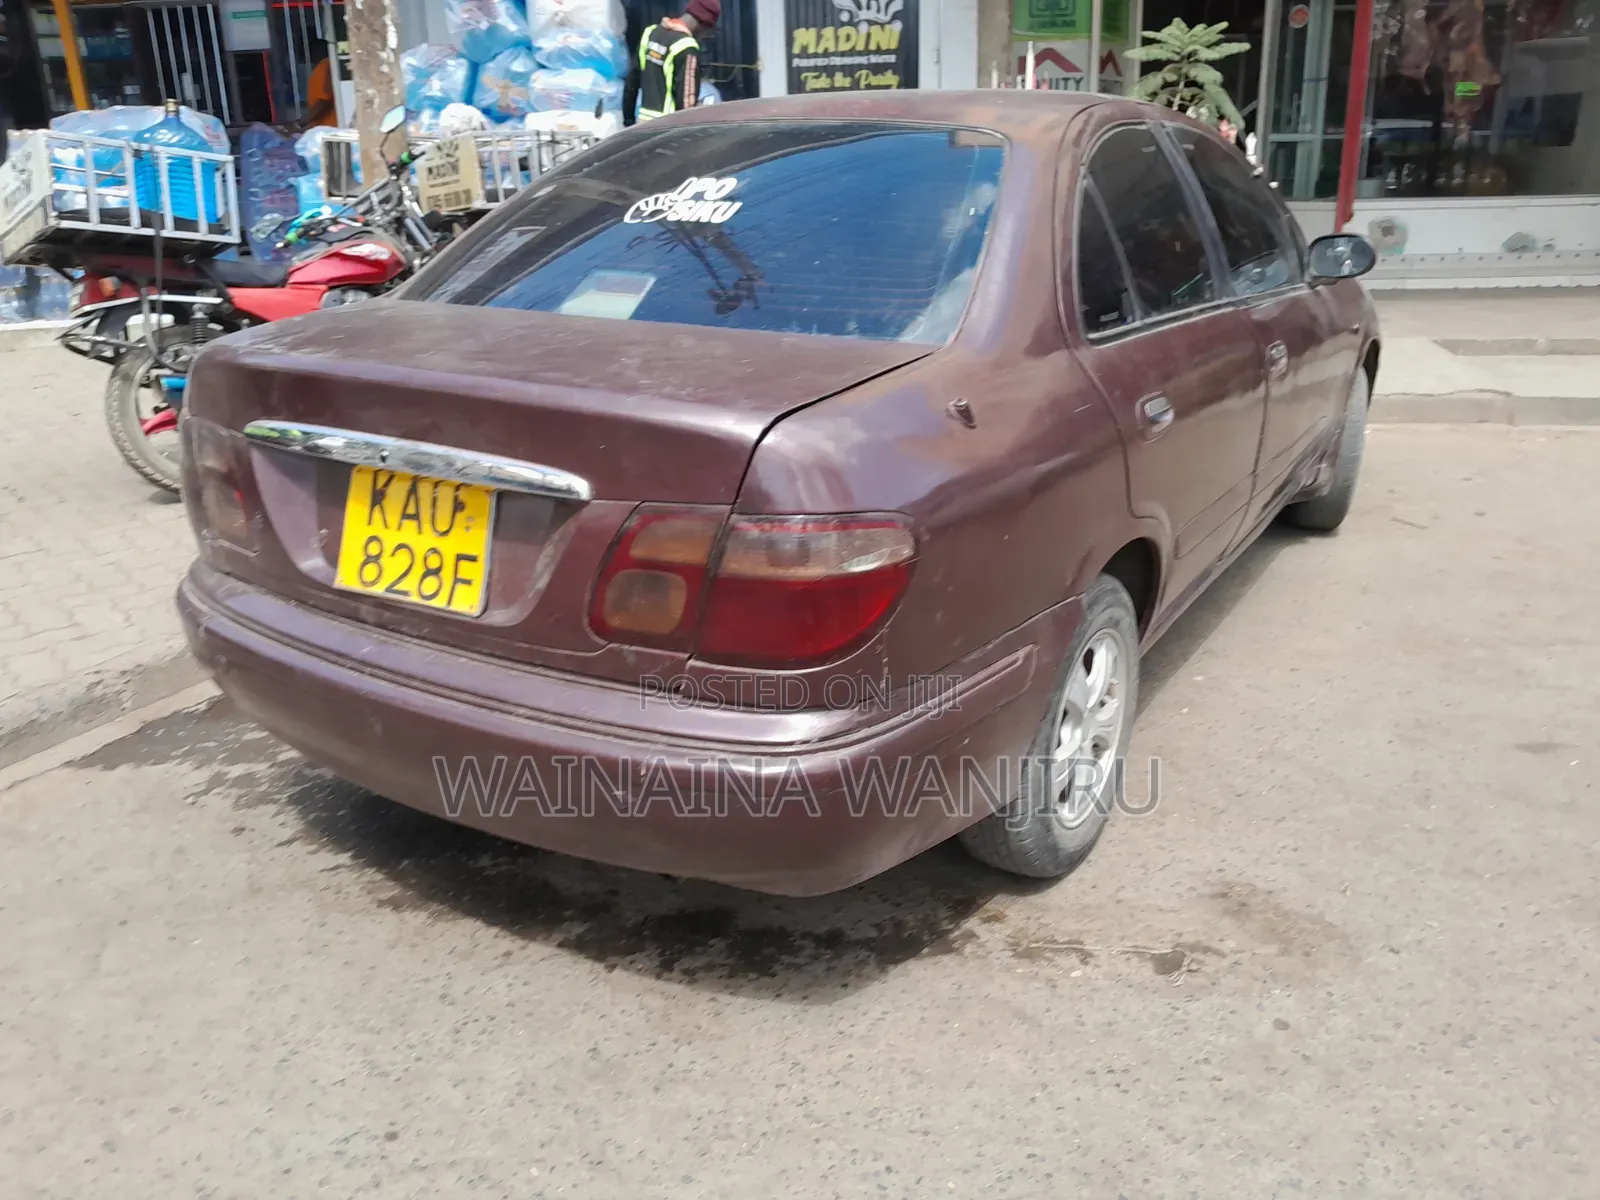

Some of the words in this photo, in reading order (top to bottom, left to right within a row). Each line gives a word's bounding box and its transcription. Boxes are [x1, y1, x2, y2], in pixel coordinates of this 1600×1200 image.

[791, 23, 903, 54] MADINI
[666, 200, 744, 223] SIKU
[367, 468, 466, 537] KAU
[359, 535, 478, 606] 828F
